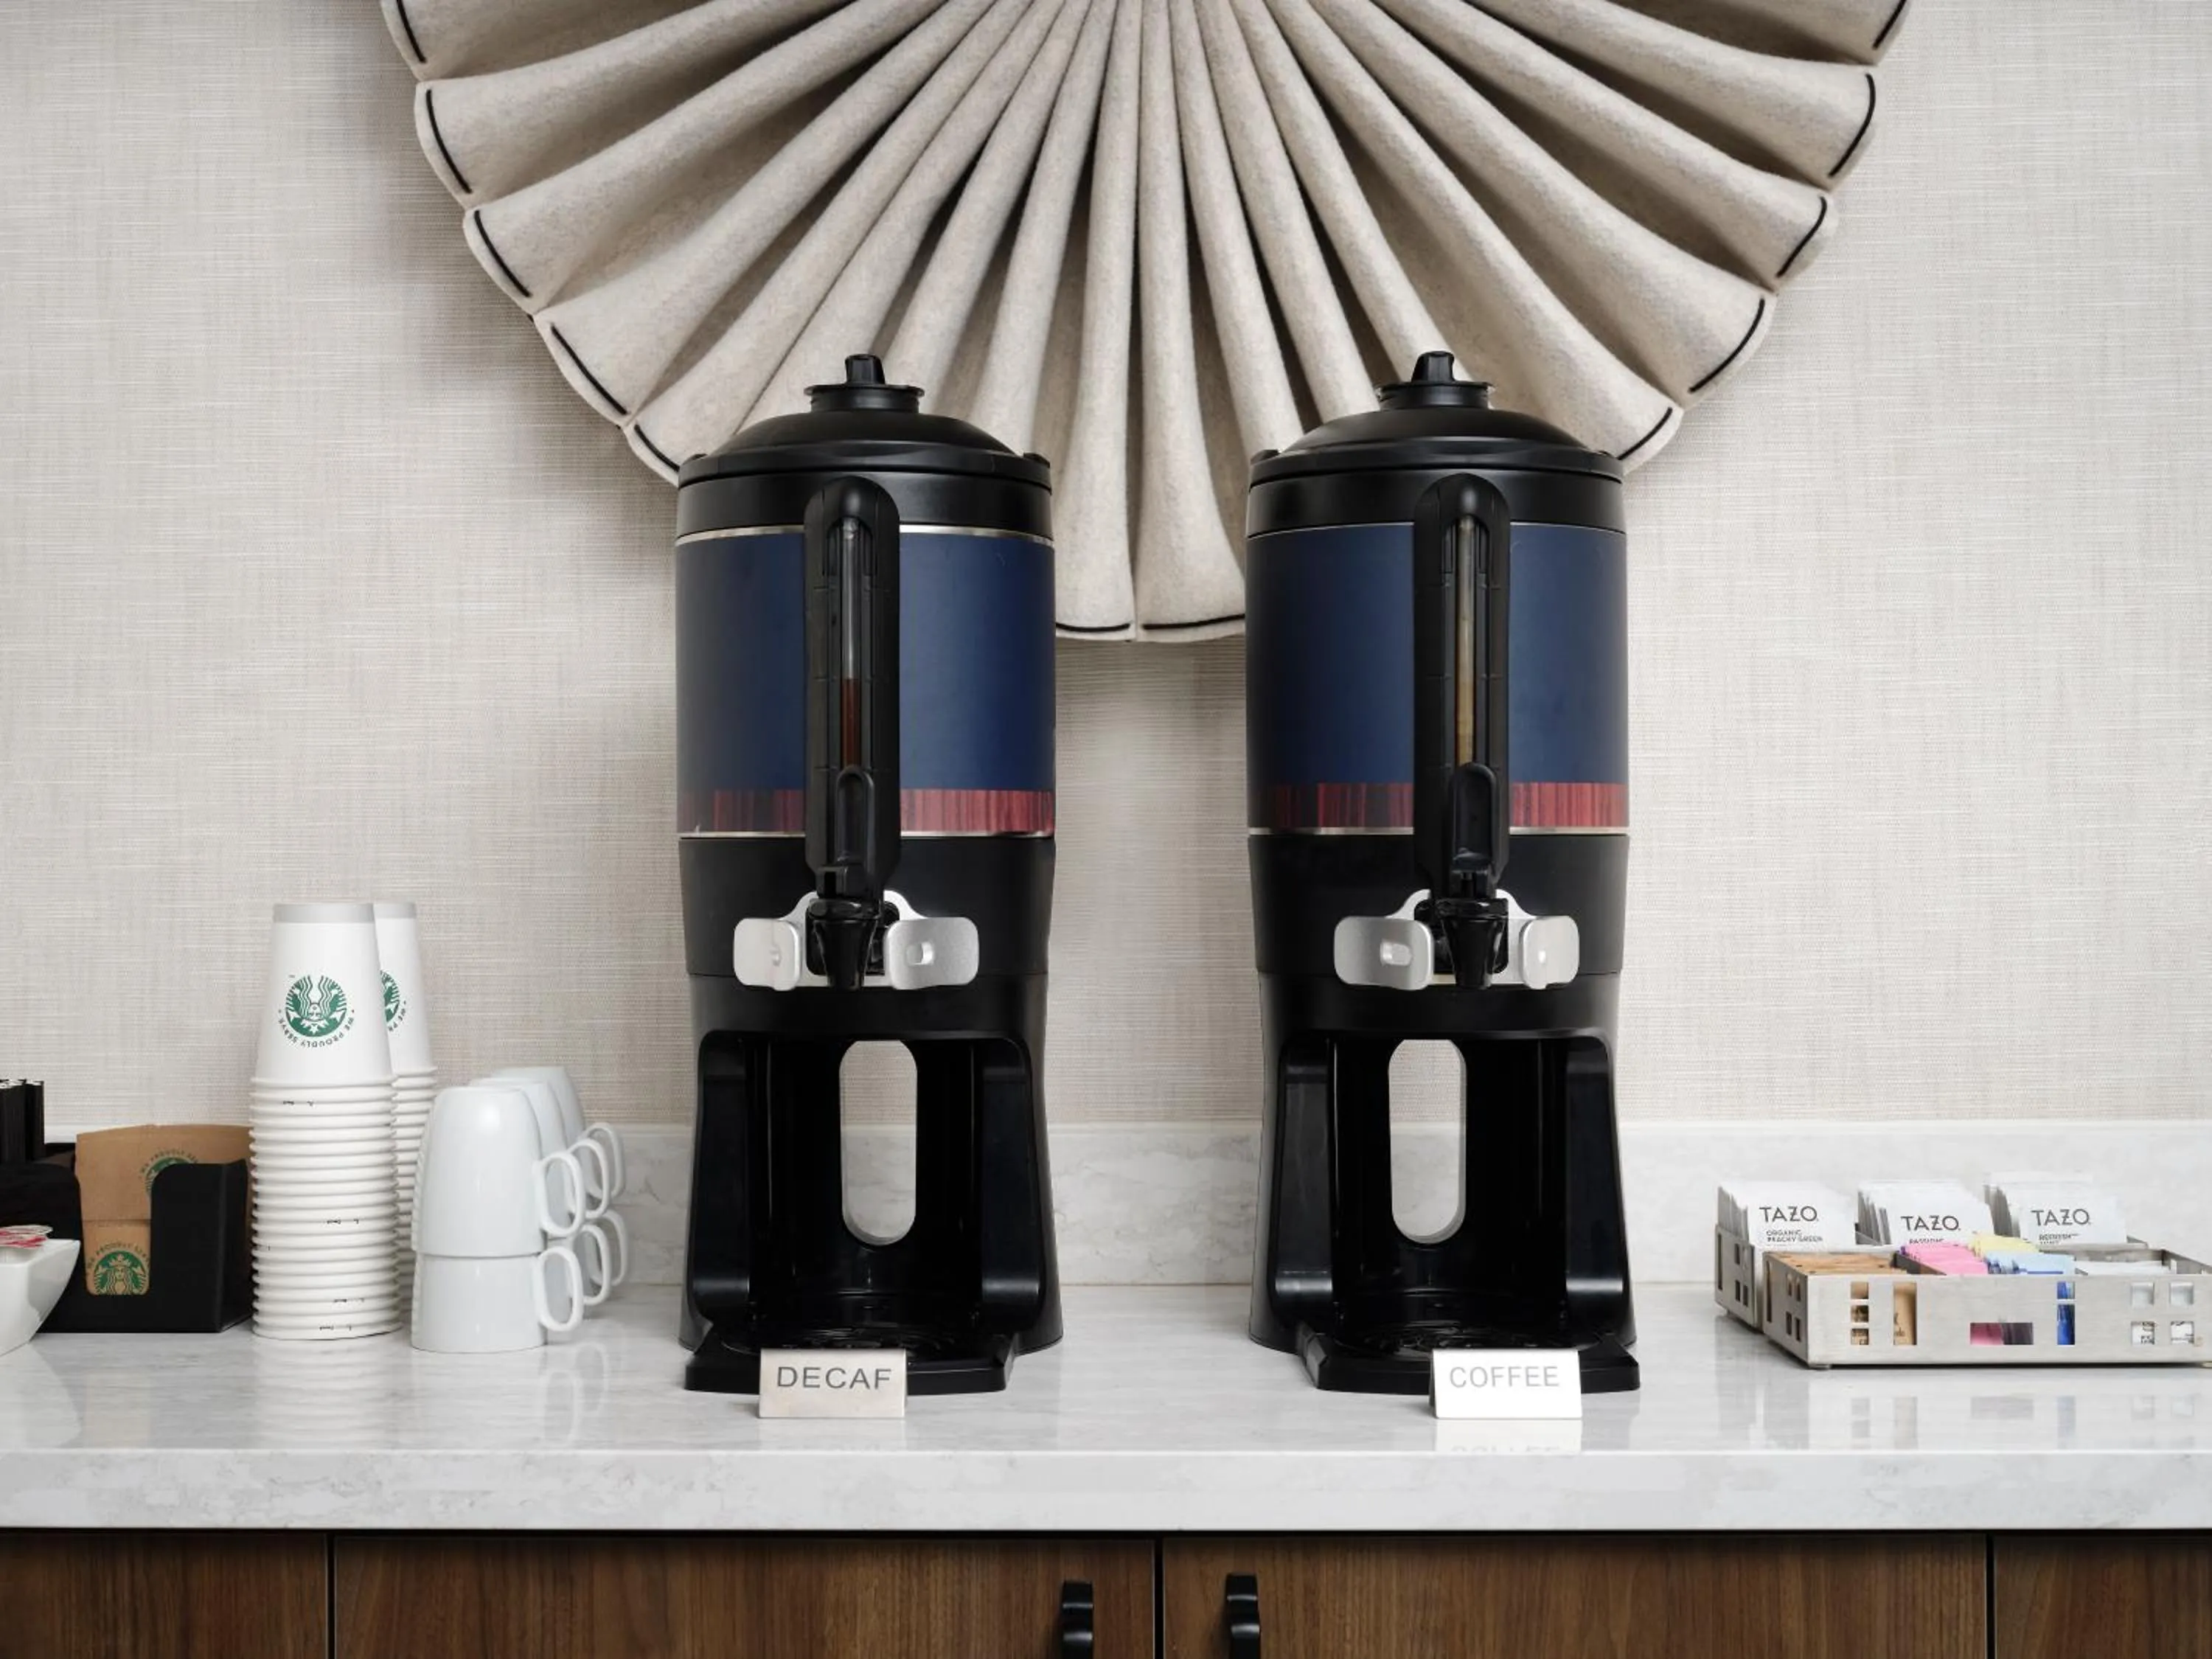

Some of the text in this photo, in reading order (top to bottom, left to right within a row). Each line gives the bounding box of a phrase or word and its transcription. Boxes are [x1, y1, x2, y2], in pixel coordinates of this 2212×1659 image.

[301, 1032, 344, 1048] PROUDLY
[1759, 1206, 1818, 1222] TAZO
[2031, 1208, 2091, 1226] TAZO
[1900, 1215, 1961, 1231] TAZO
[776, 1366, 892, 1390] DECAF
[1449, 1366, 1560, 1388] COFFEE
